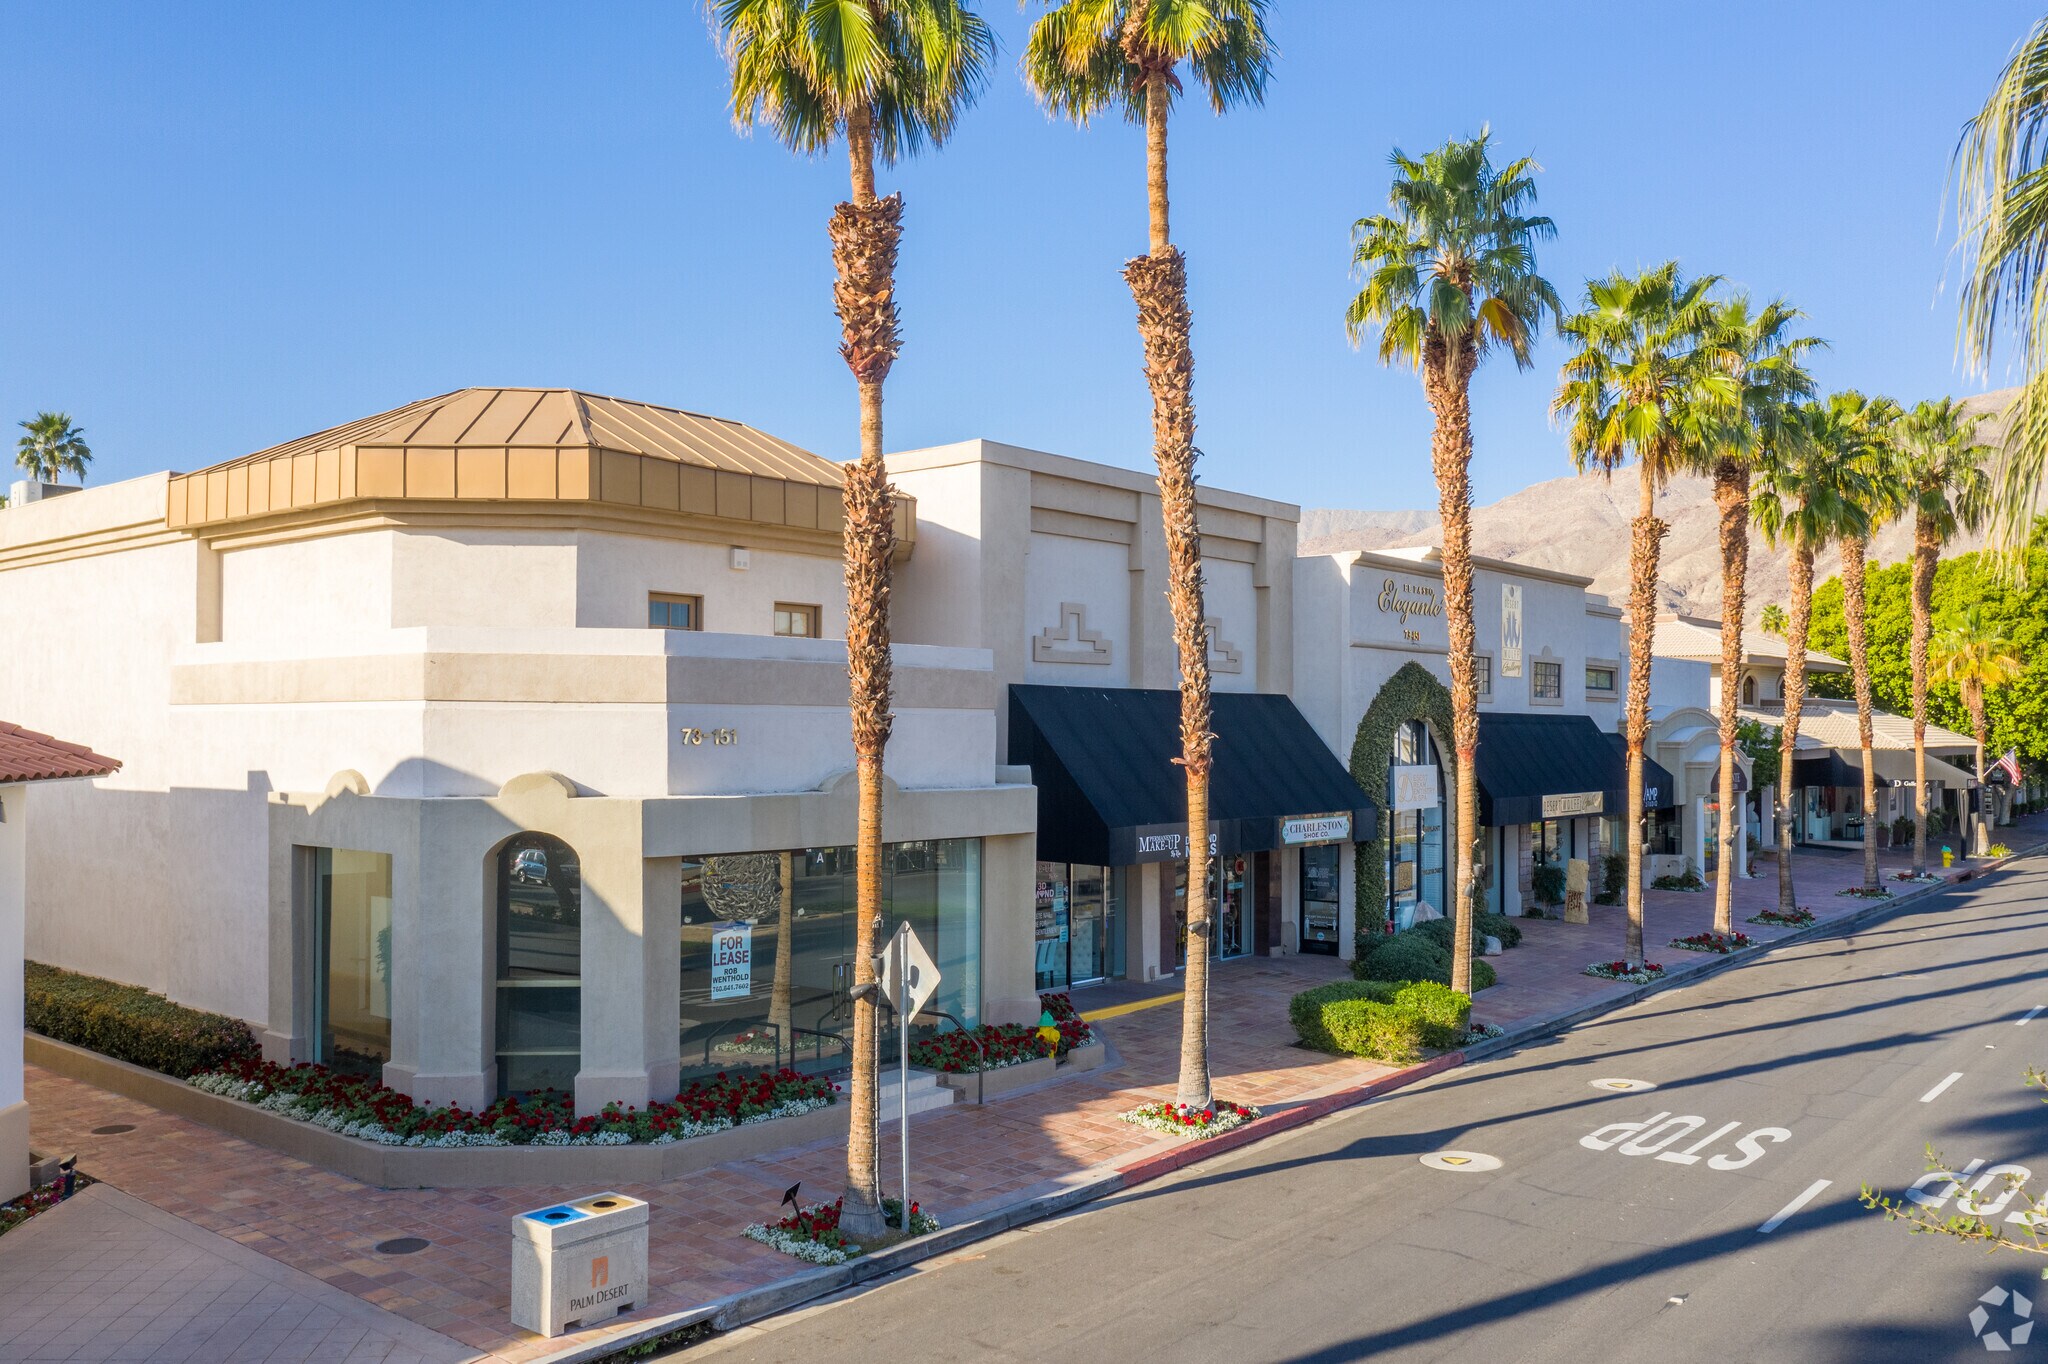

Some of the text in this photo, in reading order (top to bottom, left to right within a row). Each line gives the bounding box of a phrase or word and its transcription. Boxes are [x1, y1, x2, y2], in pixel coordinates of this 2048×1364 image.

[680, 727, 738, 746] 73-151
[1289, 820, 1343, 834] CHARLESTON
[1303, 831, 1319, 839] SHOE
[720, 936, 743, 950] FOR
[713, 950, 749, 967] LEASE
[724, 967, 738, 976] ROB
[713, 974, 749, 984] WENTHOLD
[1579, 1111, 1793, 1171] STOP
[570, 1283, 629, 1312] PALM DESERT
